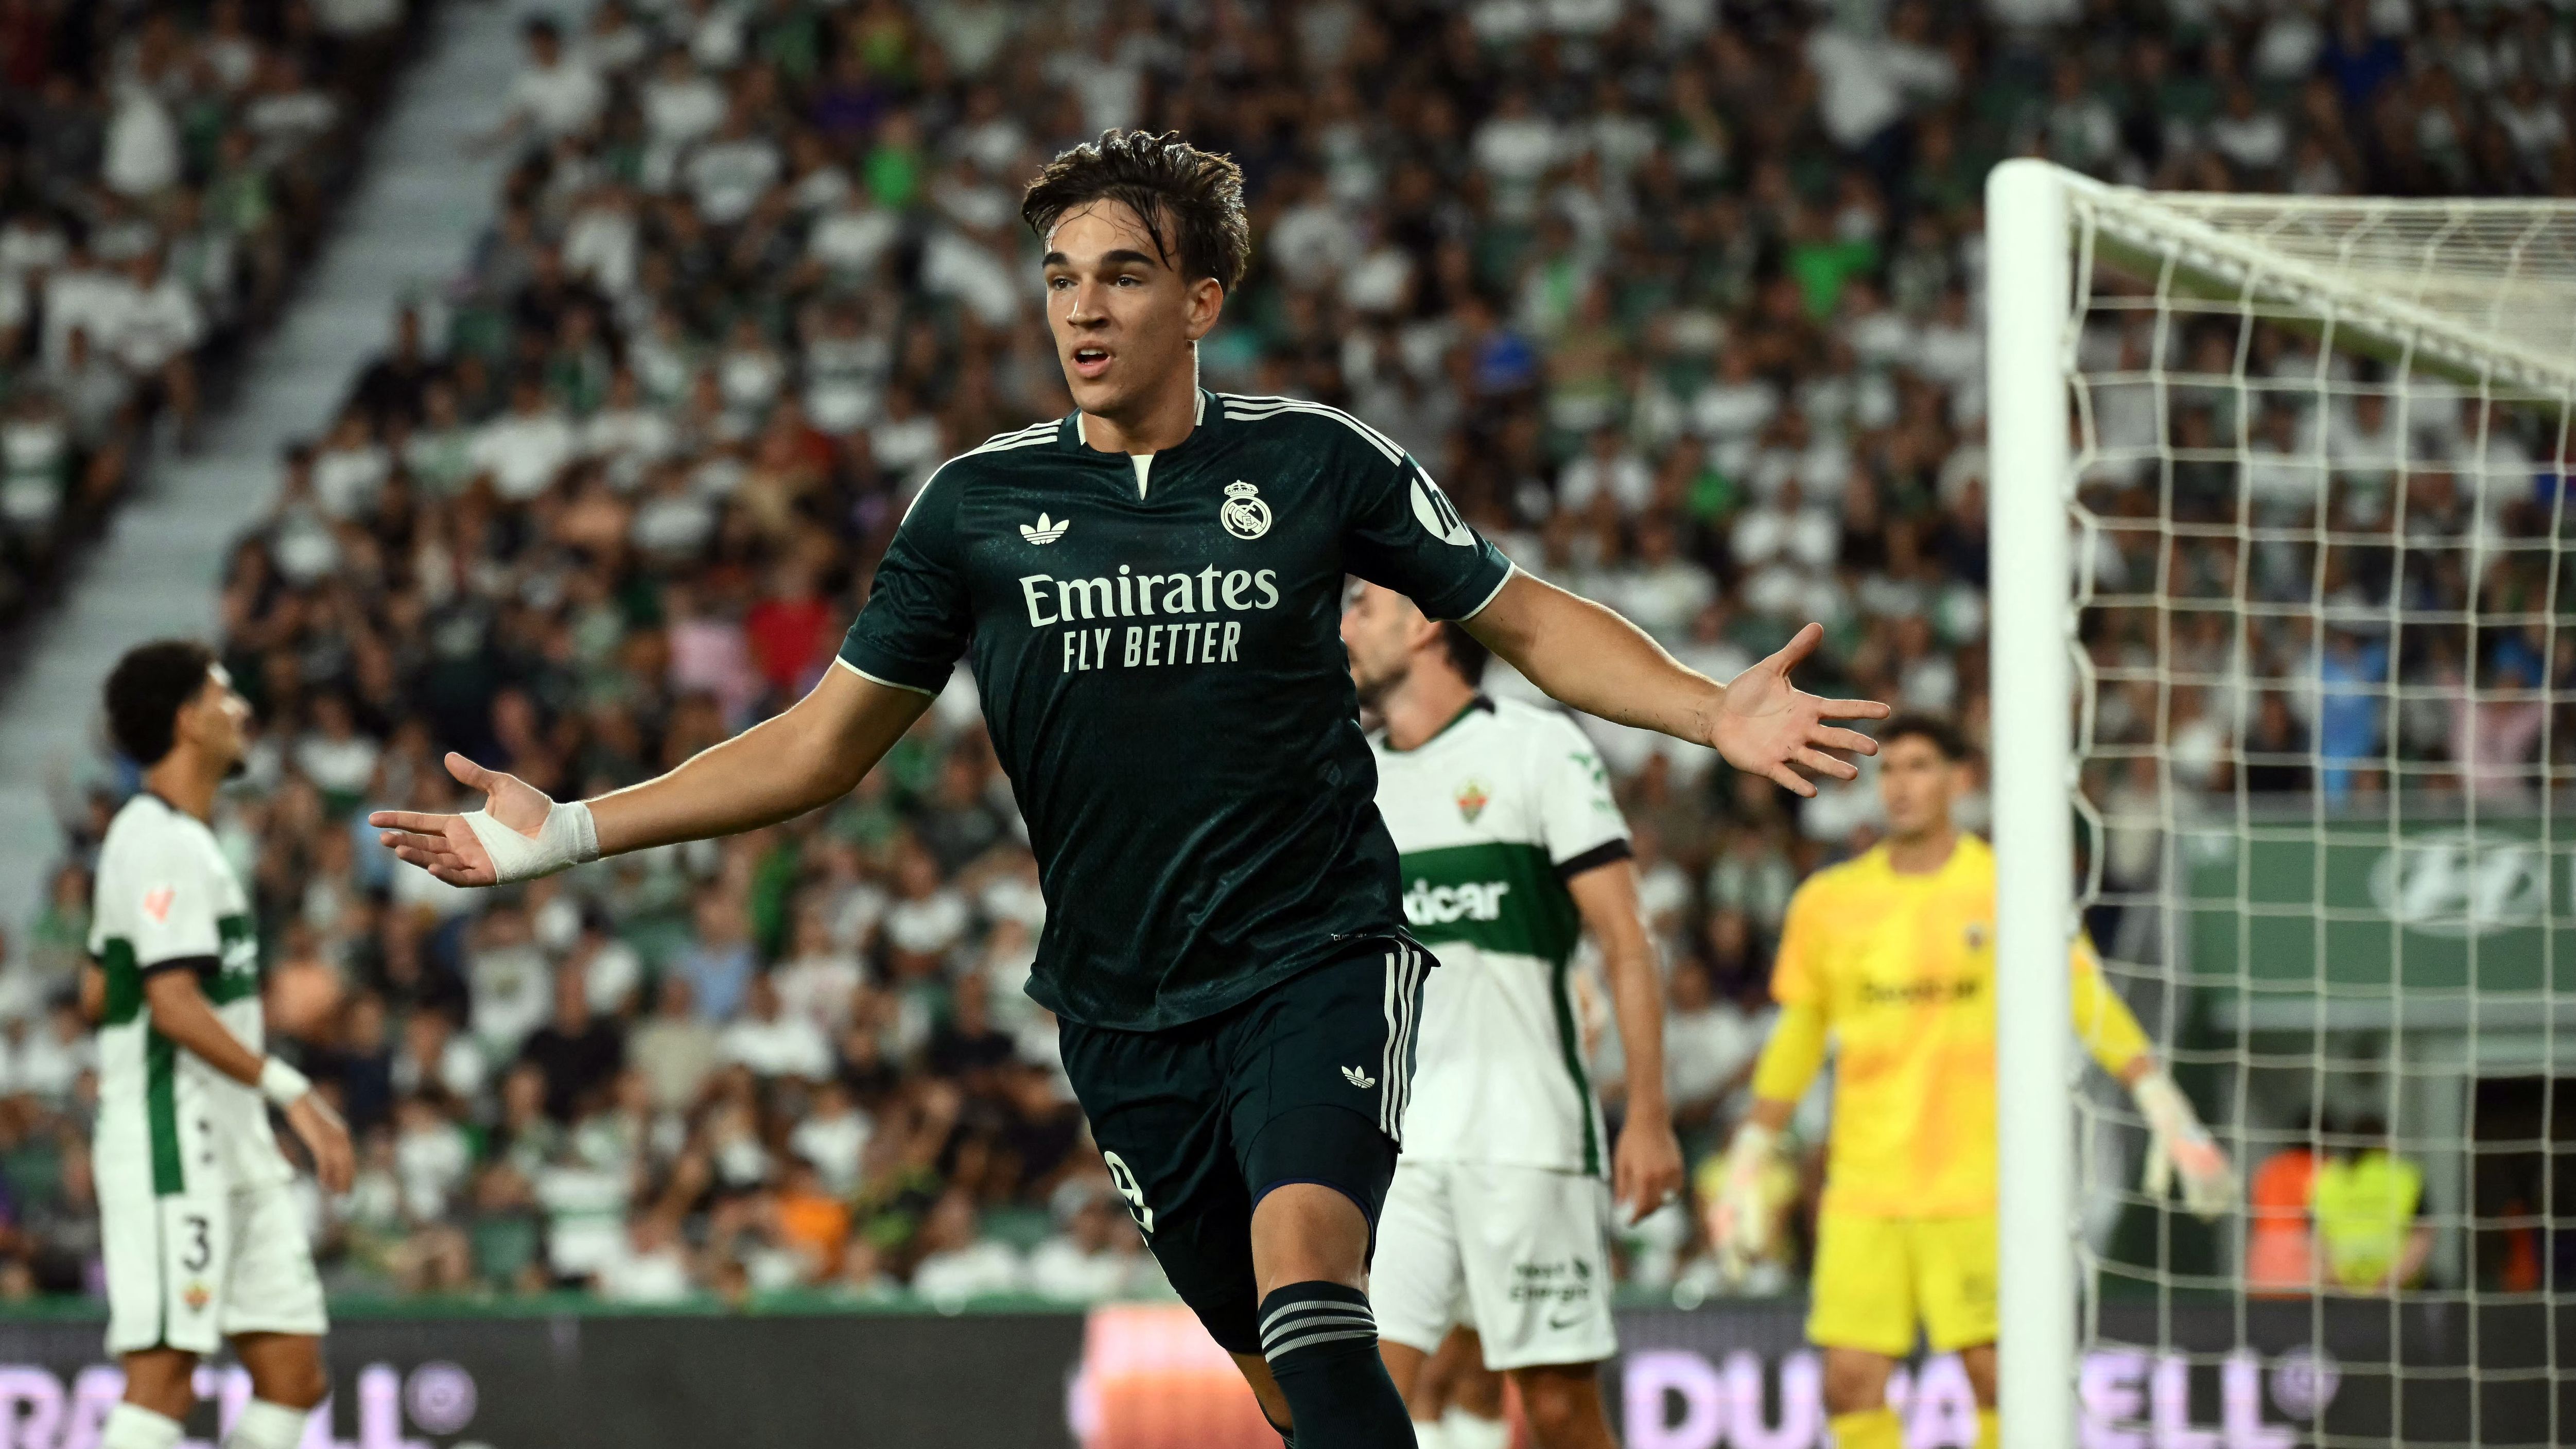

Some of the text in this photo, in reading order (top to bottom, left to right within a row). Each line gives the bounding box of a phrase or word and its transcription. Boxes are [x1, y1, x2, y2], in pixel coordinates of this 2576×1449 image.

[1019, 564, 1279, 627] Emirates
[1063, 621, 1241, 673] FLY BETTER
[183, 1215, 212, 1272] 3
[1622, 1351, 2299, 1449] DUAELL
